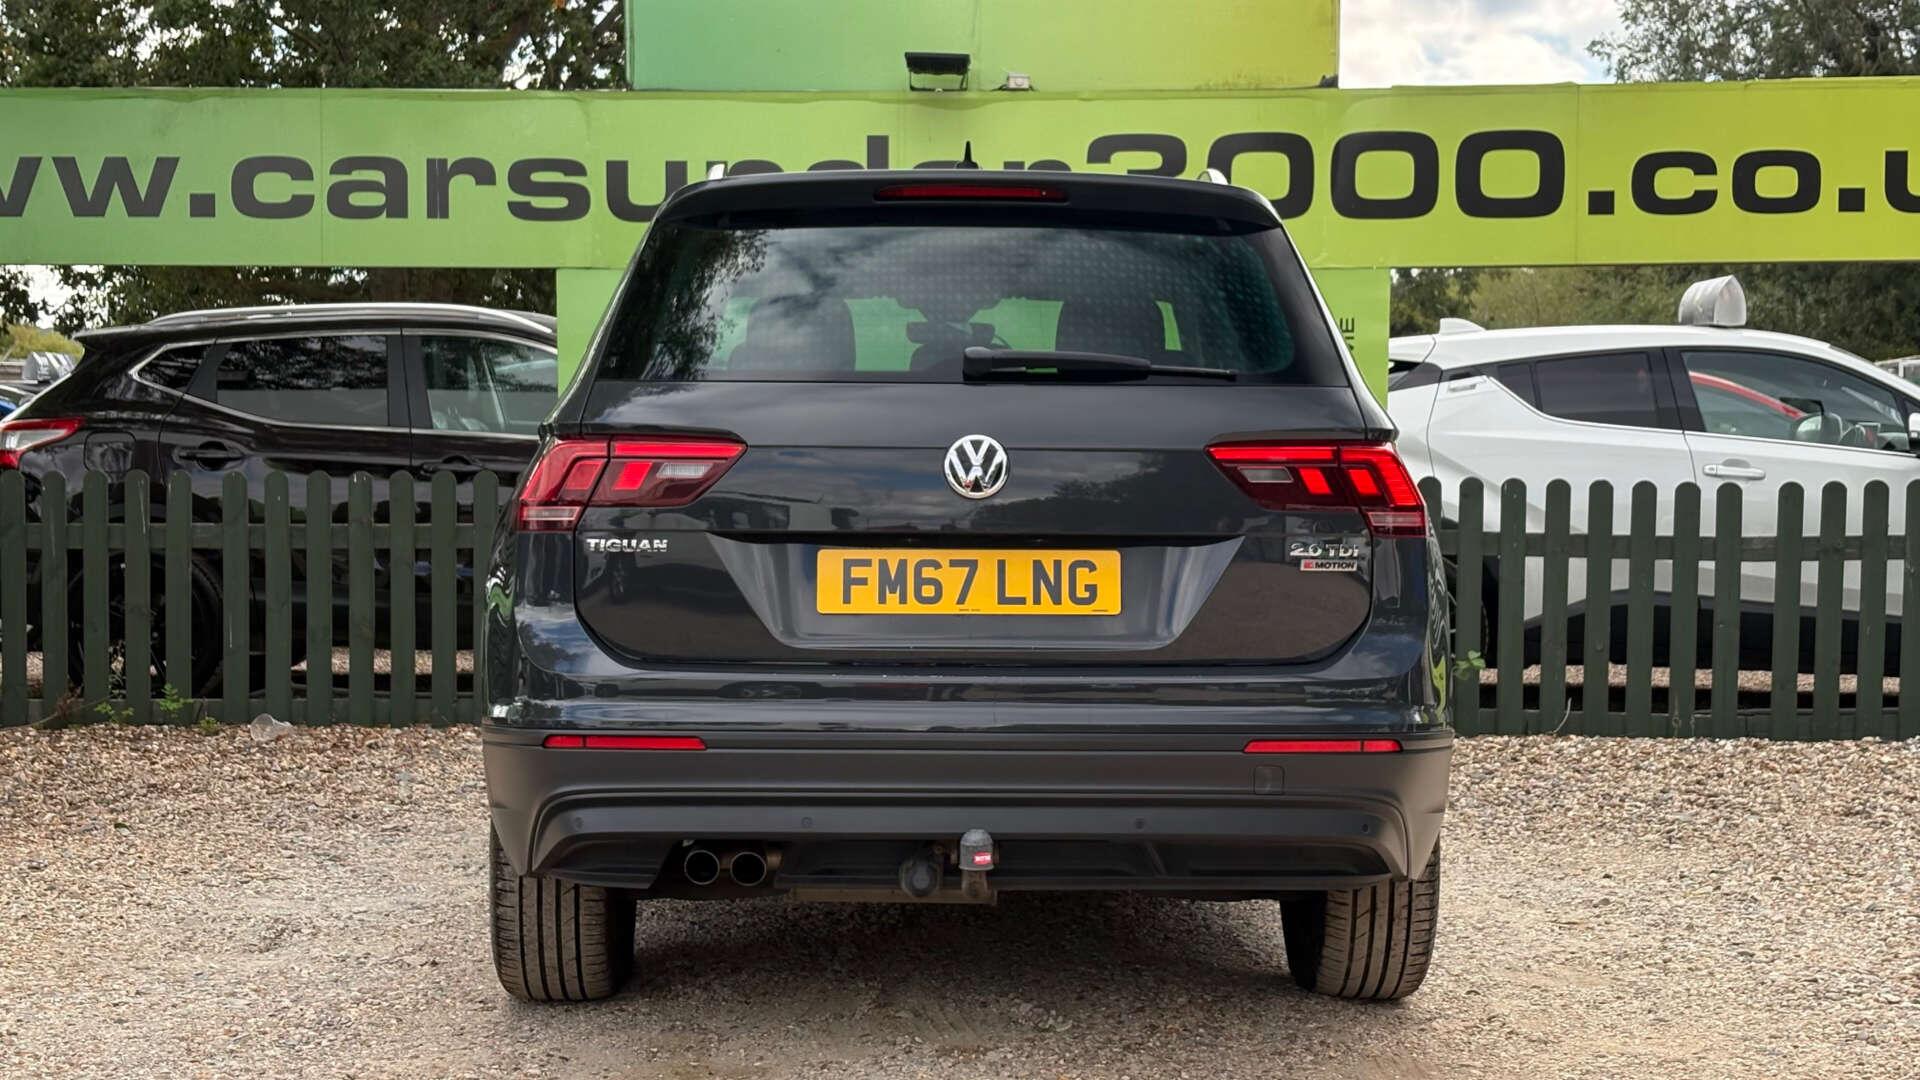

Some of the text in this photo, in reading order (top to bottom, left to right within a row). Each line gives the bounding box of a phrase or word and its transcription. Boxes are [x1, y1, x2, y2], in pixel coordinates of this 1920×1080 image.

[586, 538, 669, 552] TIGUAN
[1325, 543, 1360, 557] TDI
[842, 558, 1098, 606] FM67 LNG
